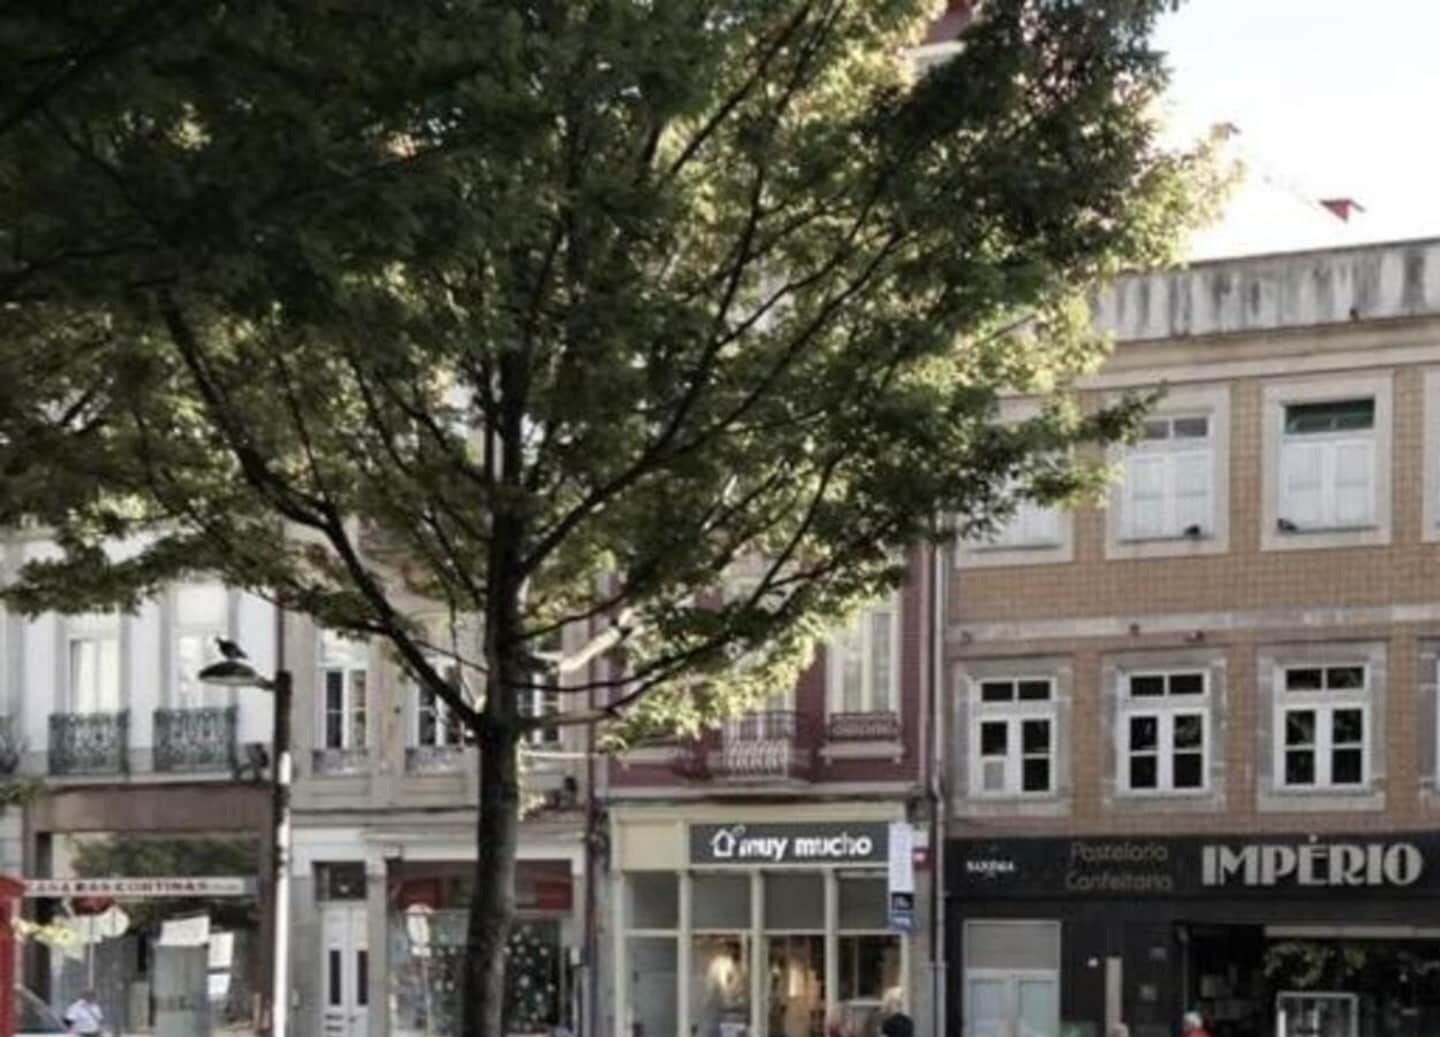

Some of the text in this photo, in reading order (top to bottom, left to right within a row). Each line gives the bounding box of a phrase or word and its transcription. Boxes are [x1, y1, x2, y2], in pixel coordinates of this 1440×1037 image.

[739, 832, 873, 861] muy mucho
[1071, 842, 1169, 864] Pastelaria
[1202, 833, 1424, 886] IMPÉRIO
[1064, 870, 1174, 892] Confeitaria
